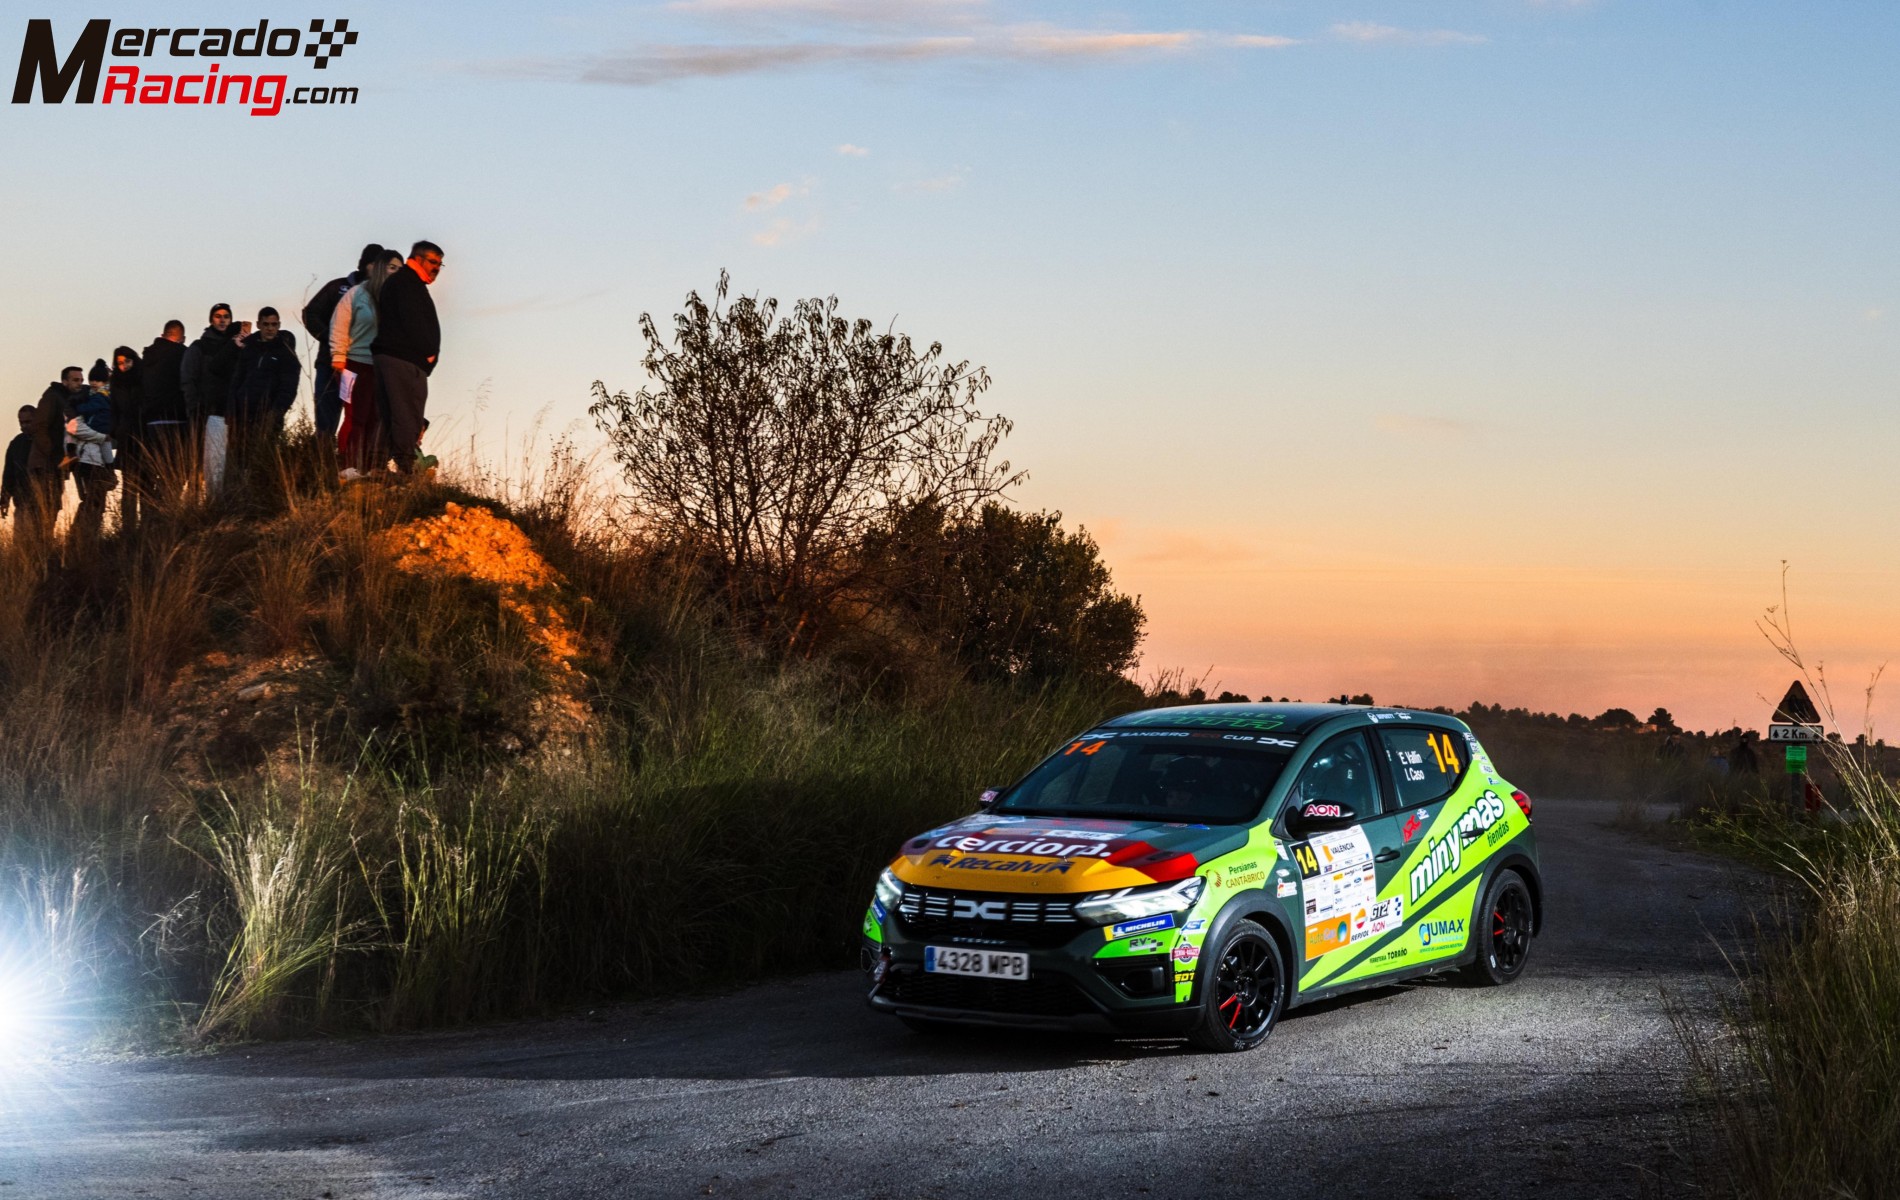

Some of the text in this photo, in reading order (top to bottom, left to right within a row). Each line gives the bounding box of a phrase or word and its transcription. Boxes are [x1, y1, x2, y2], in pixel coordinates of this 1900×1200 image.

[1222, 733, 1254, 742] CUP
[1782, 728, 1790, 739] 2
[1064, 740, 1108, 756] 14
[1426, 732, 1460, 774] 14
[1304, 804, 1340, 817] AON
[1487, 821, 1510, 847] tiendas
[1296, 845, 1318, 875] 14
[1228, 861, 1258, 875] Persianas
[1125, 919, 1166, 932] MICHELIN
[1371, 920, 1386, 933] AON
[1351, 930, 1369, 942] REPSOL
[937, 951, 1025, 977] 4328 MPB
